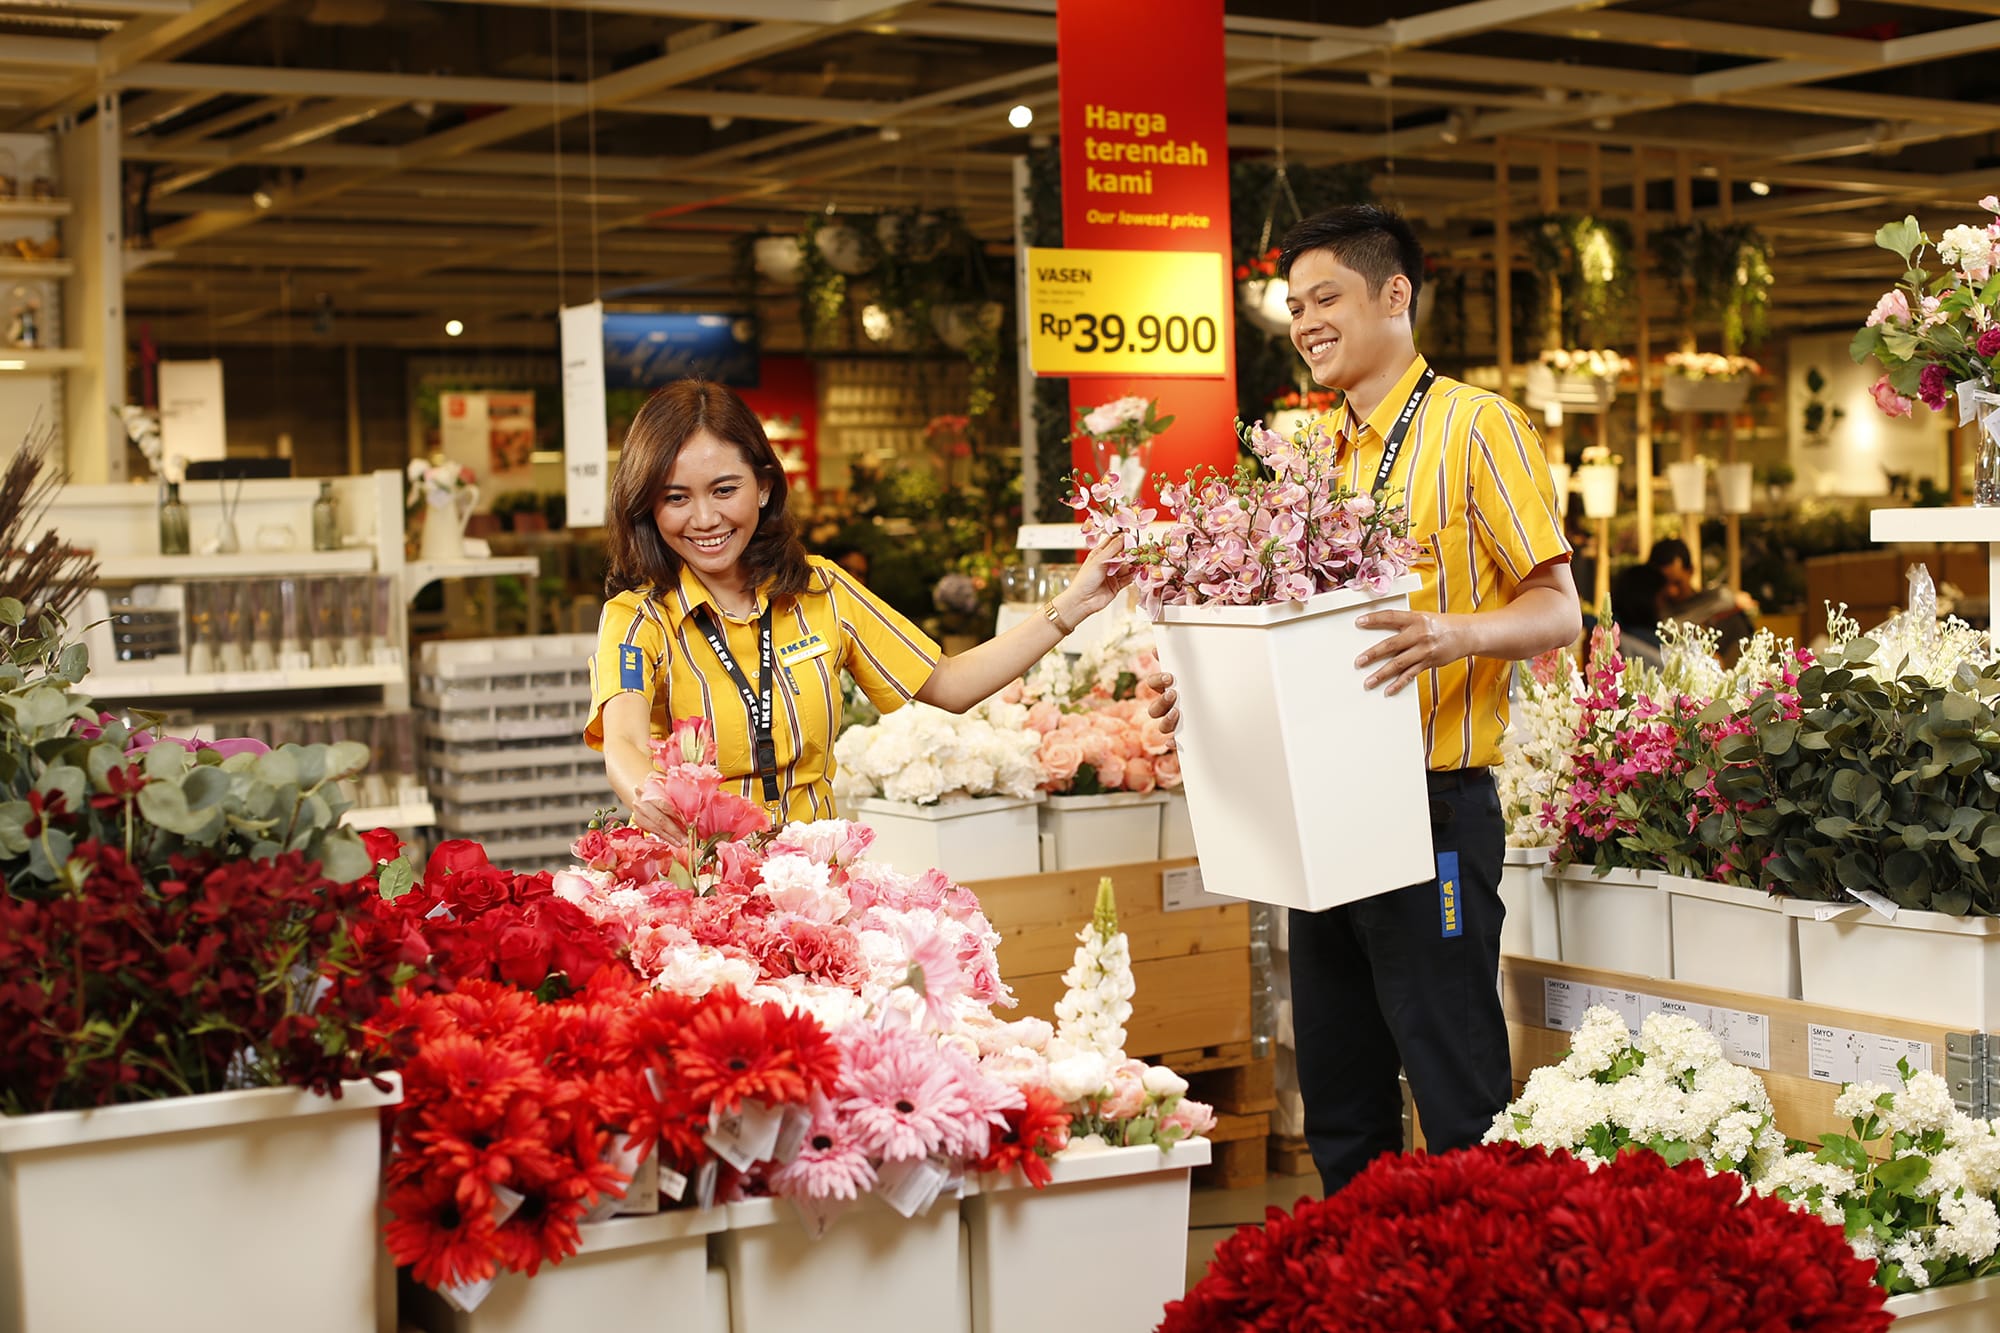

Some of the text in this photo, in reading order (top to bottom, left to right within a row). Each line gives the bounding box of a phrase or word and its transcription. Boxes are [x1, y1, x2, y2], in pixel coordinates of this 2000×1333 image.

[1085, 103, 1167, 137] Harga
[1085, 136, 1208, 166] terendah
[1086, 166, 1153, 195] kami
[1086, 208, 1210, 230] Our lowest price
[1036, 268, 1092, 283] VASEN
[1401, 391, 1423, 423] IKEA
[1378, 441, 1399, 478] IKEA
[707, 634, 735, 672] IKEA
[763, 629, 771, 668] IKEA
[779, 634, 821, 656] IKEA
[761, 689, 771, 729] IKEA
[1443, 880, 1456, 931] IKEA
[1548, 980, 1570, 991] SMYCKA
[1661, 1001, 1687, 1012] SMYCKA
